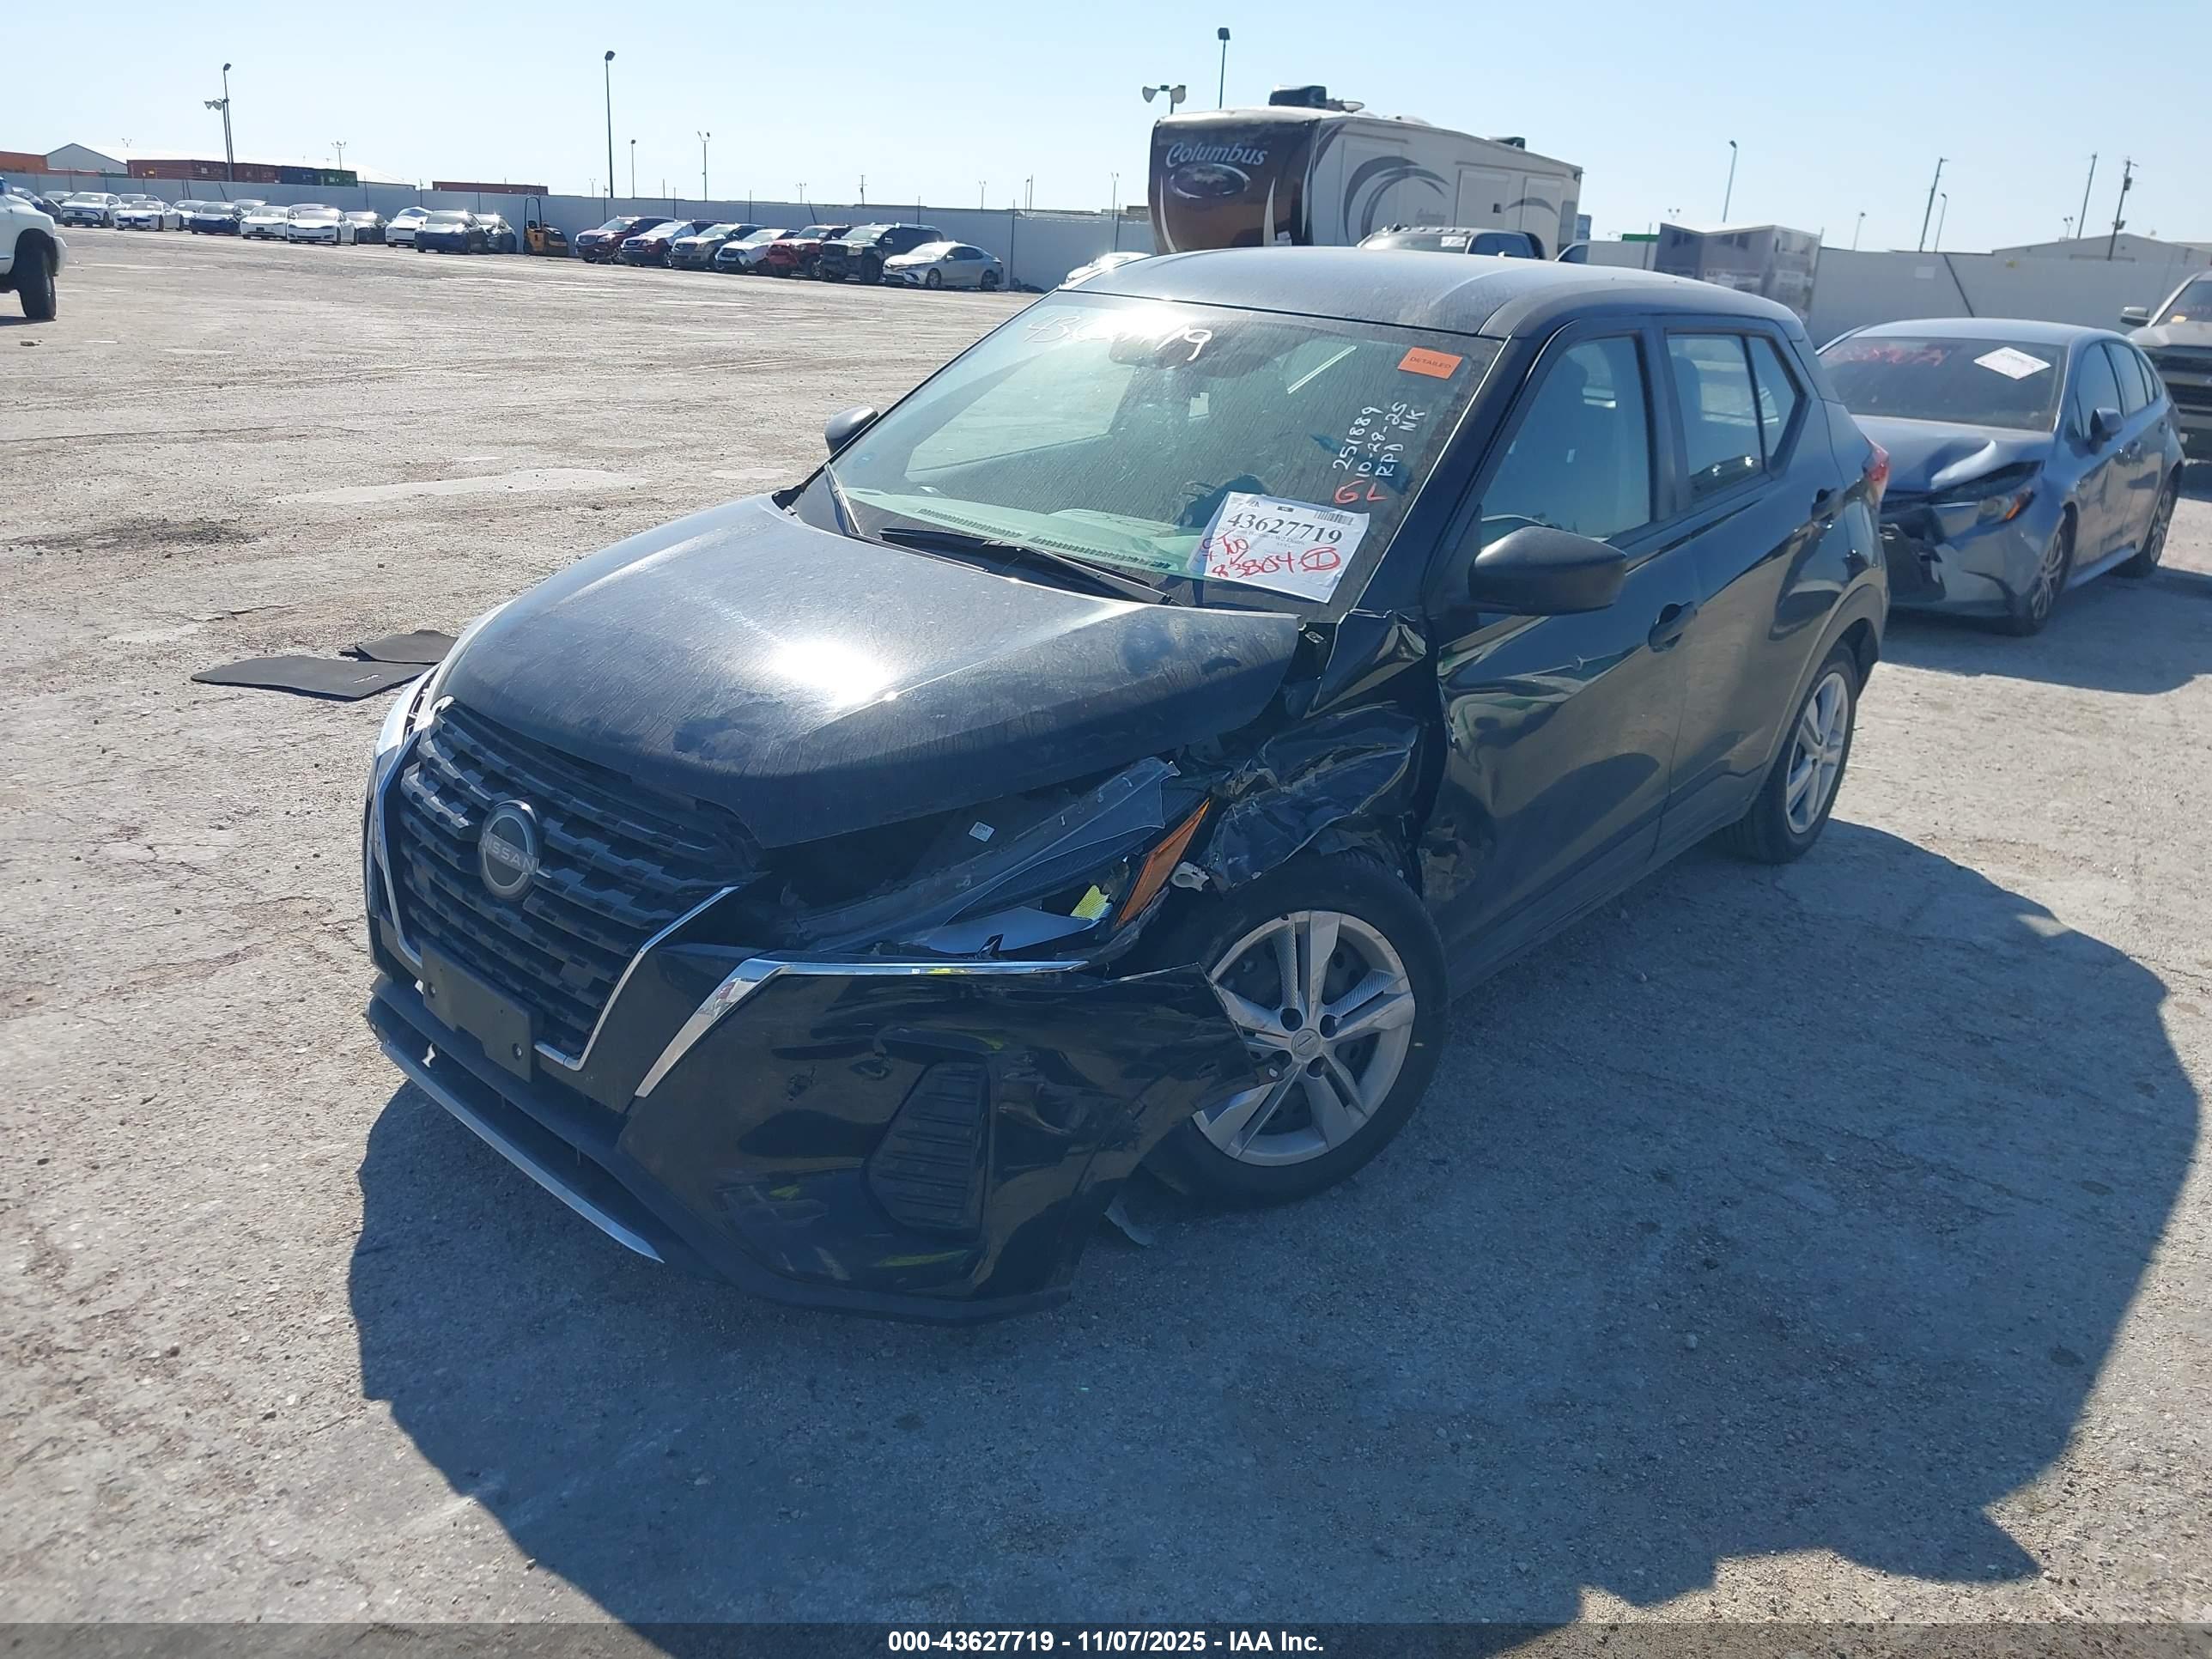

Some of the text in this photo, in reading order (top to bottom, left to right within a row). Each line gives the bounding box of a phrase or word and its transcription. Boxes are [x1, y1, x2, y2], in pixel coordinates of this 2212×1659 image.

[1165, 142, 1268, 168] Columbus
[1409, 356, 1452, 369] DETAILED
[1333, 405, 1383, 471] 251889
[1355, 401, 1407, 477] 10-28-25
[1226, 512, 1343, 544] 43627719
[480, 832, 535, 872] NISSAN
